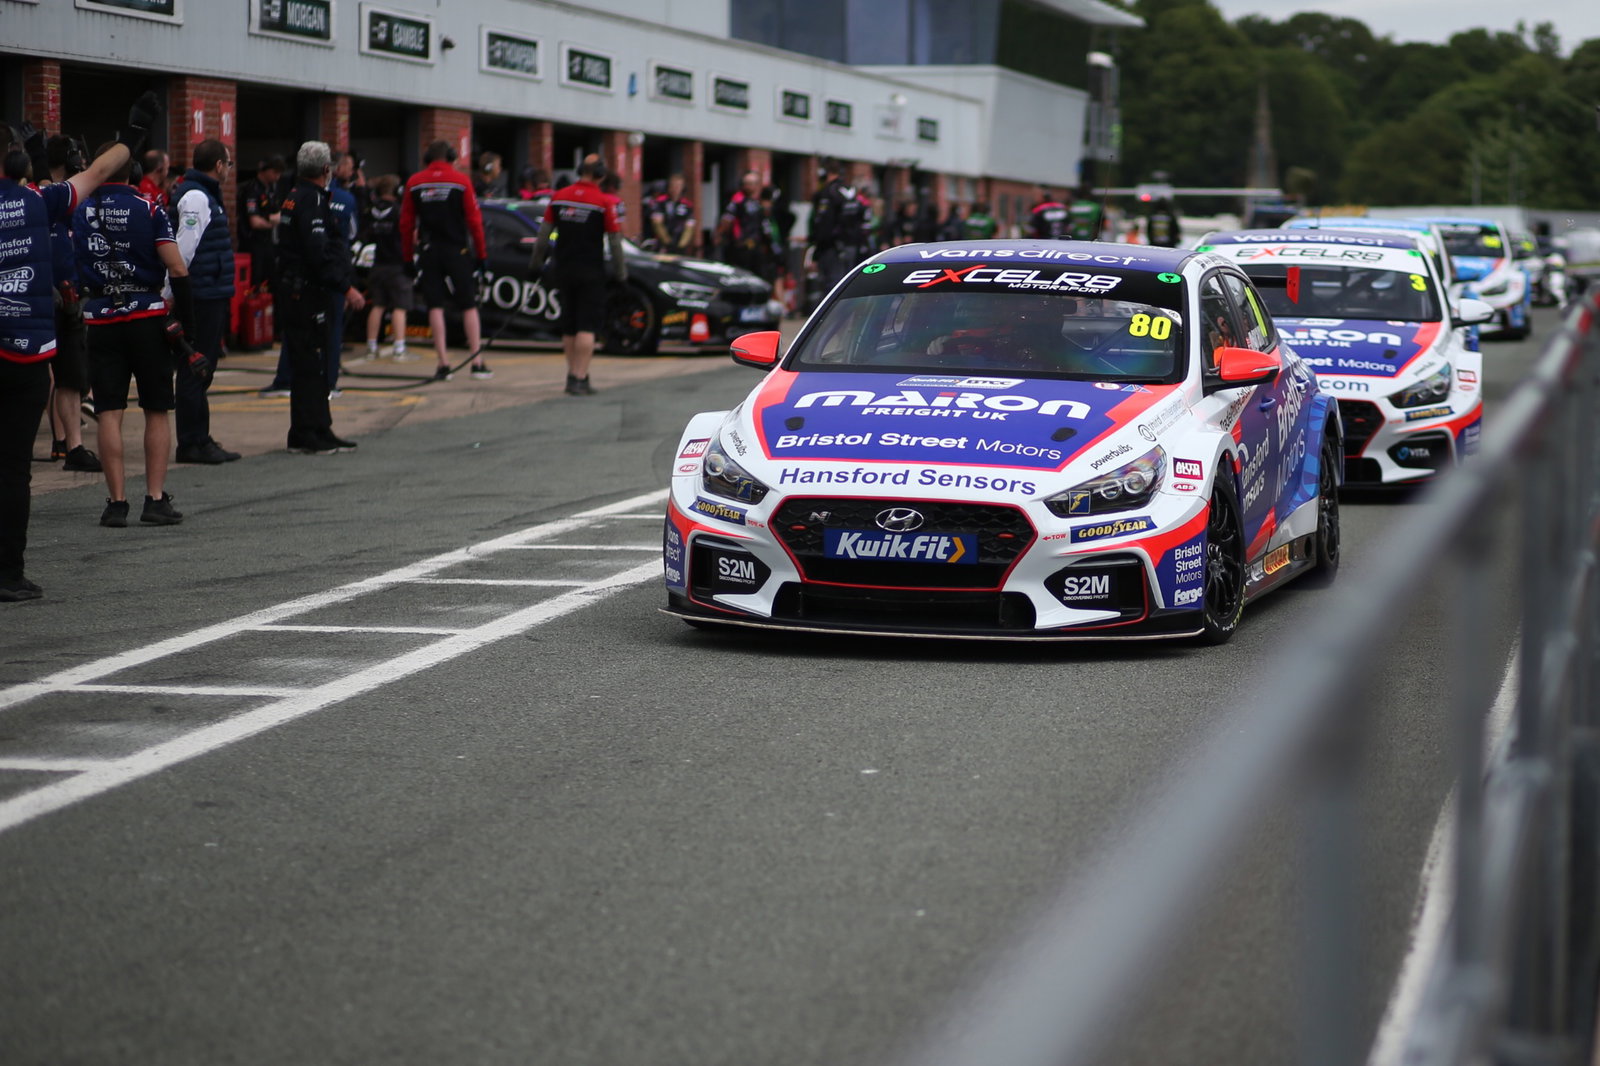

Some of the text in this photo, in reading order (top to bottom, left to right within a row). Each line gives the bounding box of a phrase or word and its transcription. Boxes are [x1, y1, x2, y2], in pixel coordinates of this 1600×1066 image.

[286, 1, 325, 31] MORGAN
[392, 22, 426, 50] GAMBLE
[193, 109, 204, 135] 11
[105, 208, 131, 216] Bristol
[105, 216, 128, 224] Street
[0, 237, 32, 250] nsford
[1236, 244, 1385, 263] EXCELR8
[0, 280, 28, 293] ools
[902, 264, 1122, 290] EXCELR8
[1408, 274, 1428, 292] 3
[1007, 282, 1110, 294] MOTORSPORT
[1128, 313, 1173, 340] 80
[1326, 340, 1352, 348] UK
[1338, 358, 1397, 373] Motors
[861, 406, 1011, 421] FREIGHT UK
[775, 432, 1063, 461] Bristol Street Motors
[1410, 448, 1430, 457] VITA
[1090, 443, 1134, 471] powerbulbs
[1275, 428, 1305, 501] Motors
[778, 467, 1037, 496] Hansford Sensors
[1078, 519, 1148, 539] GOODYEAR
[1174, 542, 1203, 561] Bristol
[718, 556, 756, 579] S2M
[1175, 557, 1202, 573] Street
[1063, 575, 1110, 596] S2M
[1175, 570, 1202, 585] Motors
[1173, 586, 1203, 602] Forge
